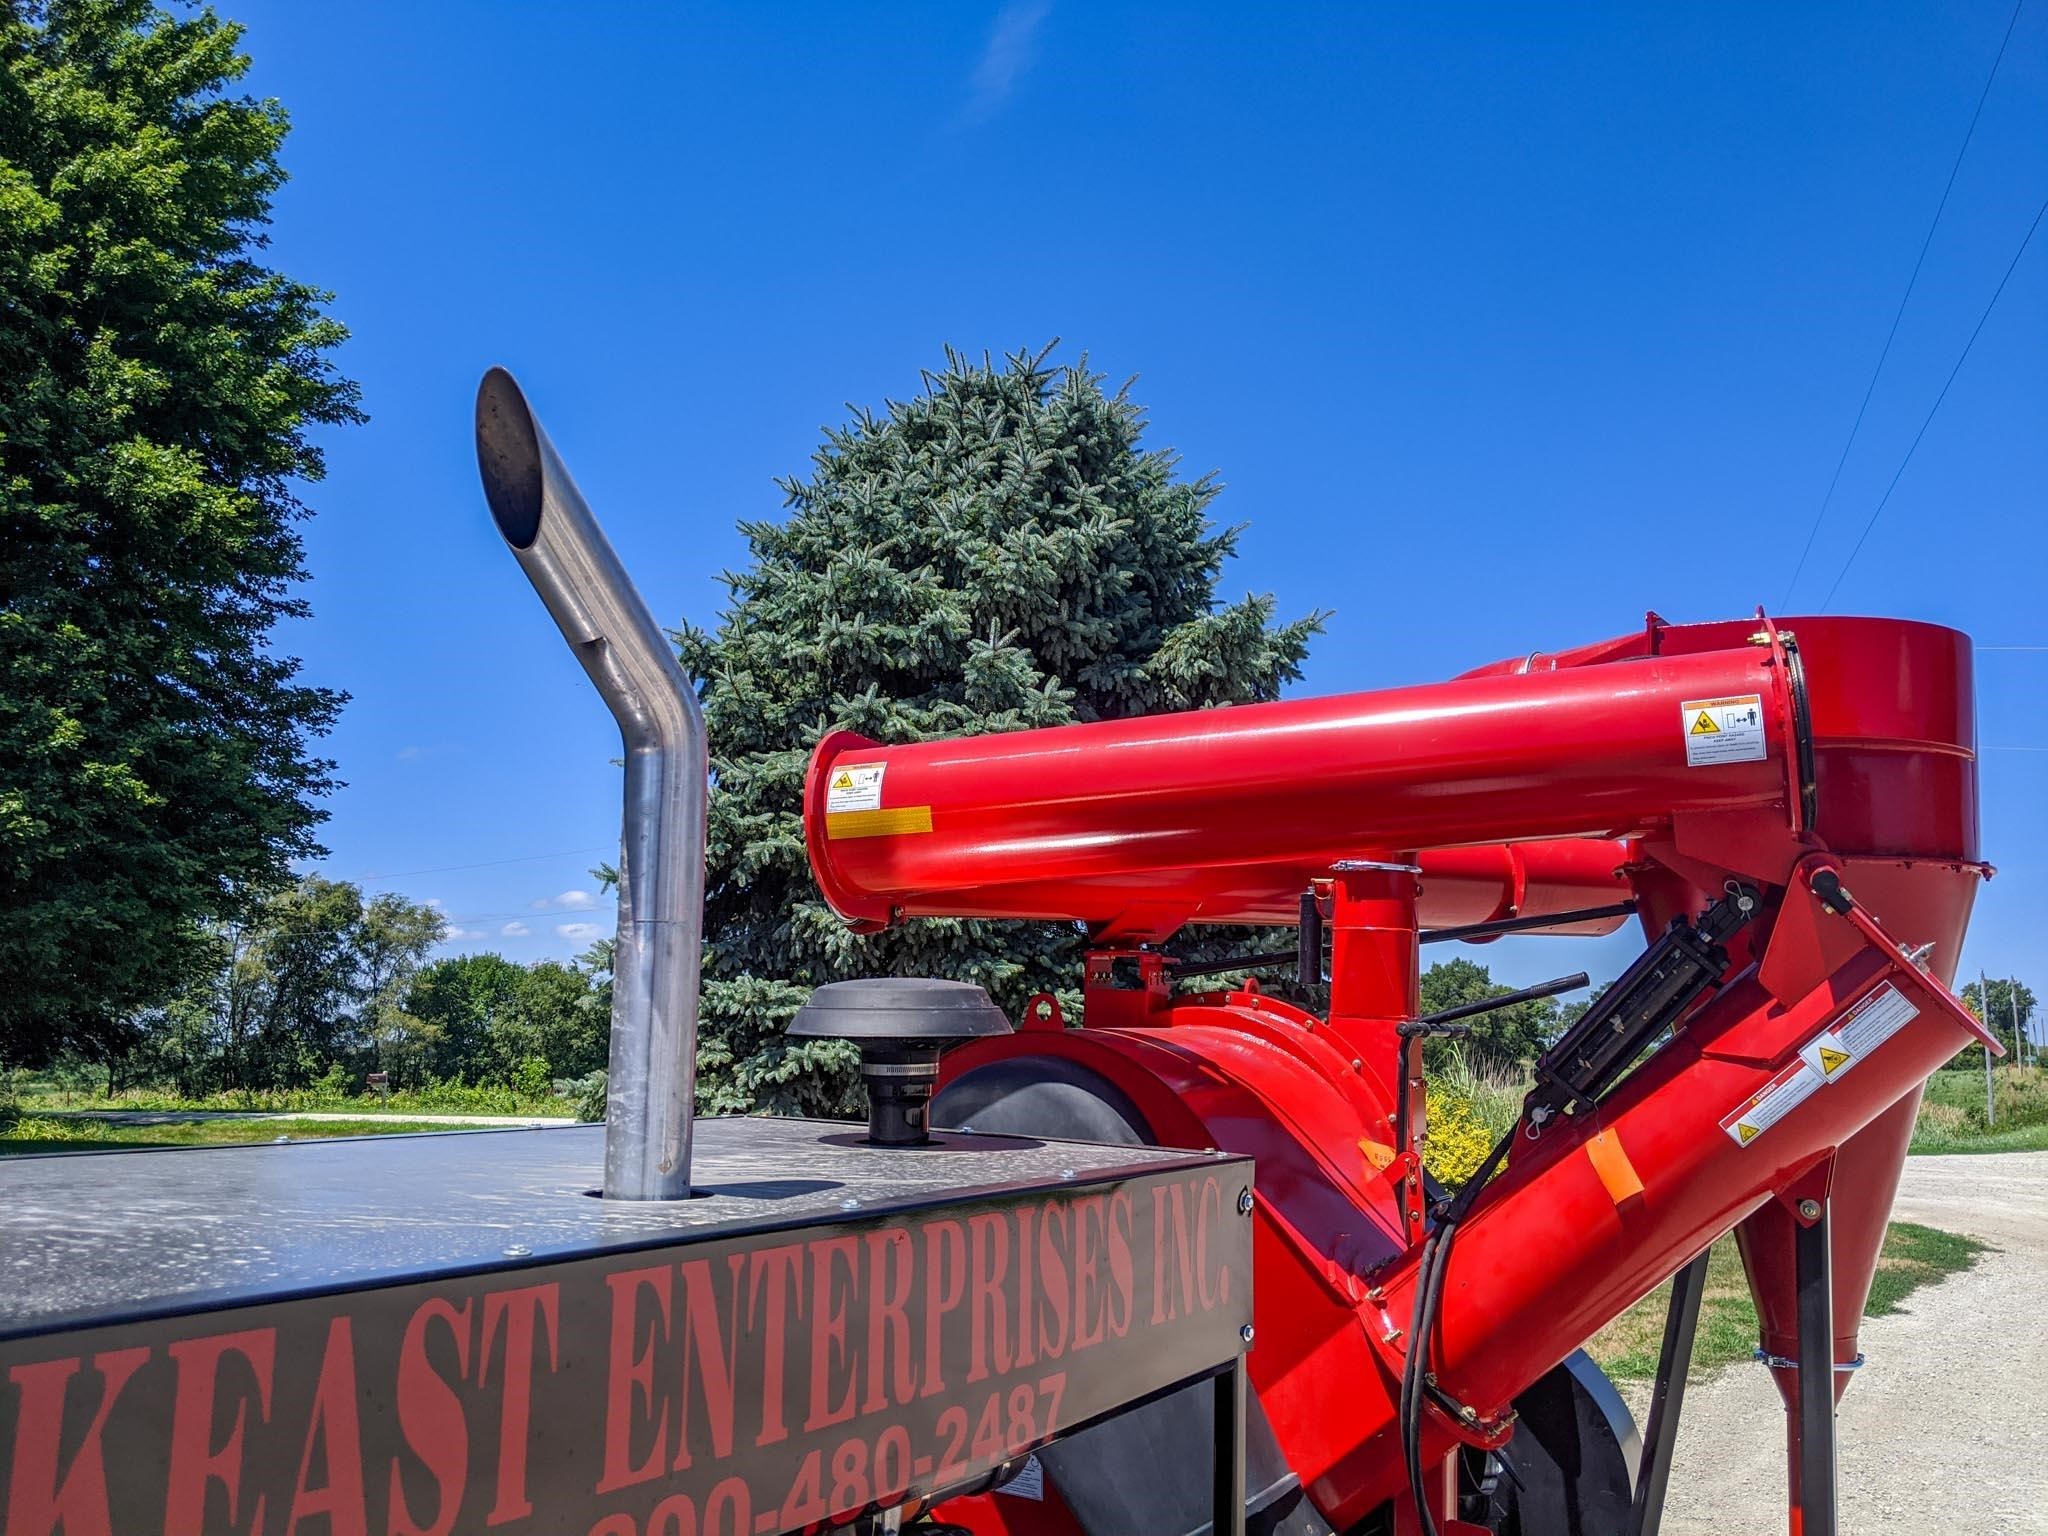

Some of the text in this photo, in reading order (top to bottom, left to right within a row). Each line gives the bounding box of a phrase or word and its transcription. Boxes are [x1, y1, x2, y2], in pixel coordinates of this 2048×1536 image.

[1852, 997, 1874, 1015] DANGER
[1756, 1083, 1777, 1100] DANGER
[7, 1176, 1230, 1536] KEAST ENTERPRISES INC.
[588, 1372, 1067, 1536] 0-480-2487
